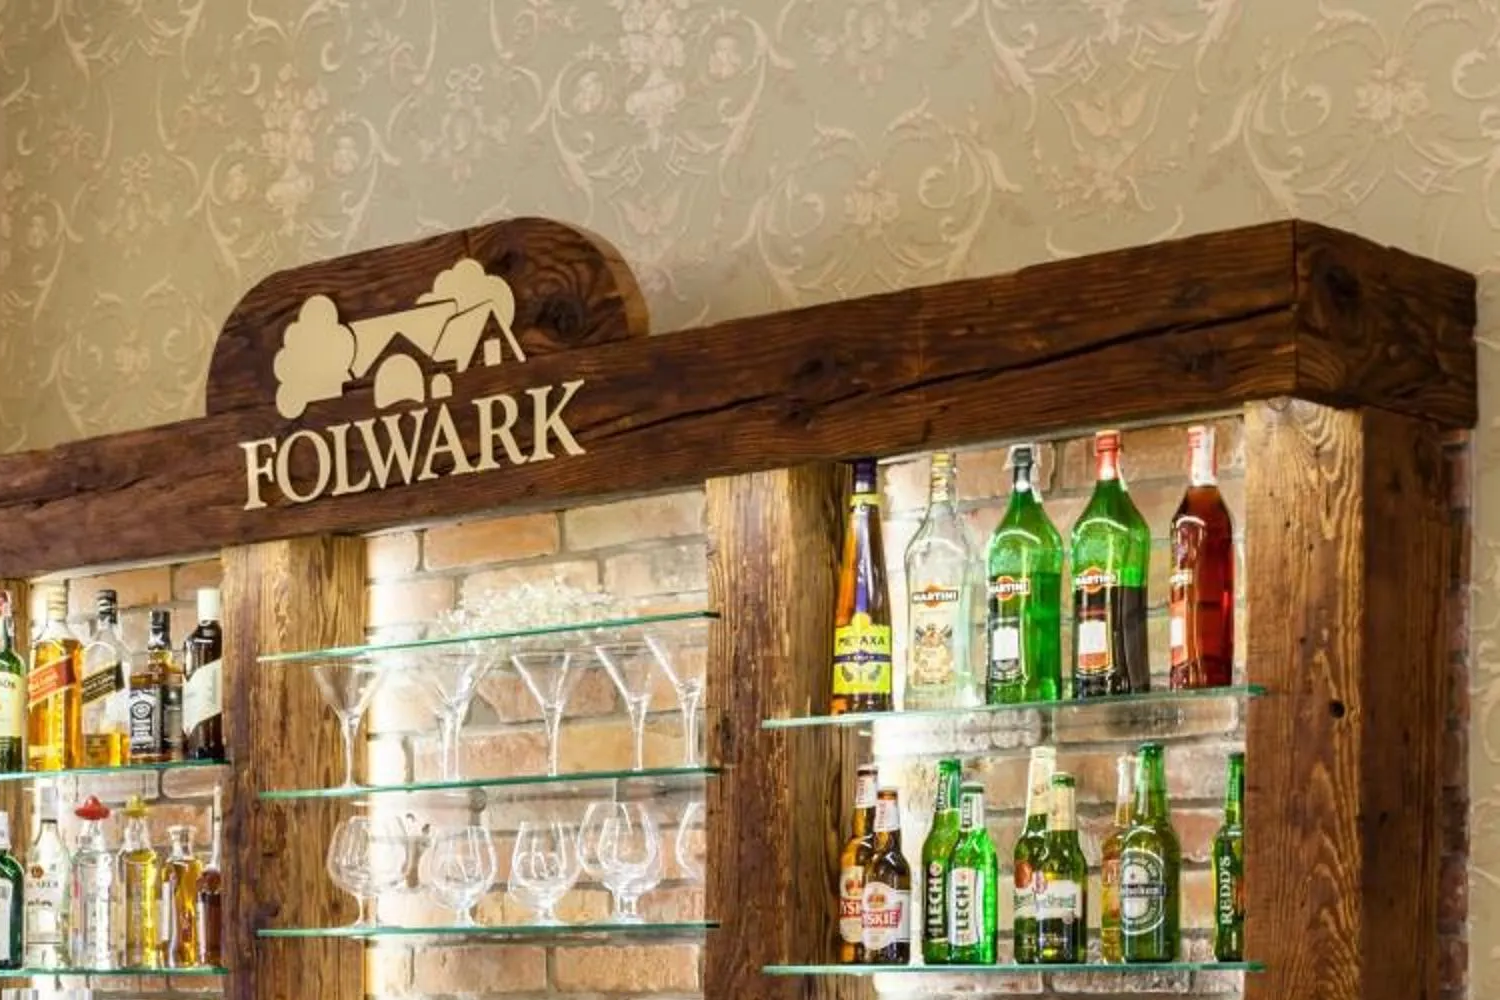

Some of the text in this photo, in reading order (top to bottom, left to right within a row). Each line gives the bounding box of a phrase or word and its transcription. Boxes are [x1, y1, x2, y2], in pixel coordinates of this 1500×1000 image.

[239, 379, 586, 511] FOLWARK
[928, 877, 943, 925] LECH
[956, 886, 969, 930] LECH
[1219, 855, 1235, 925] REDD'S
